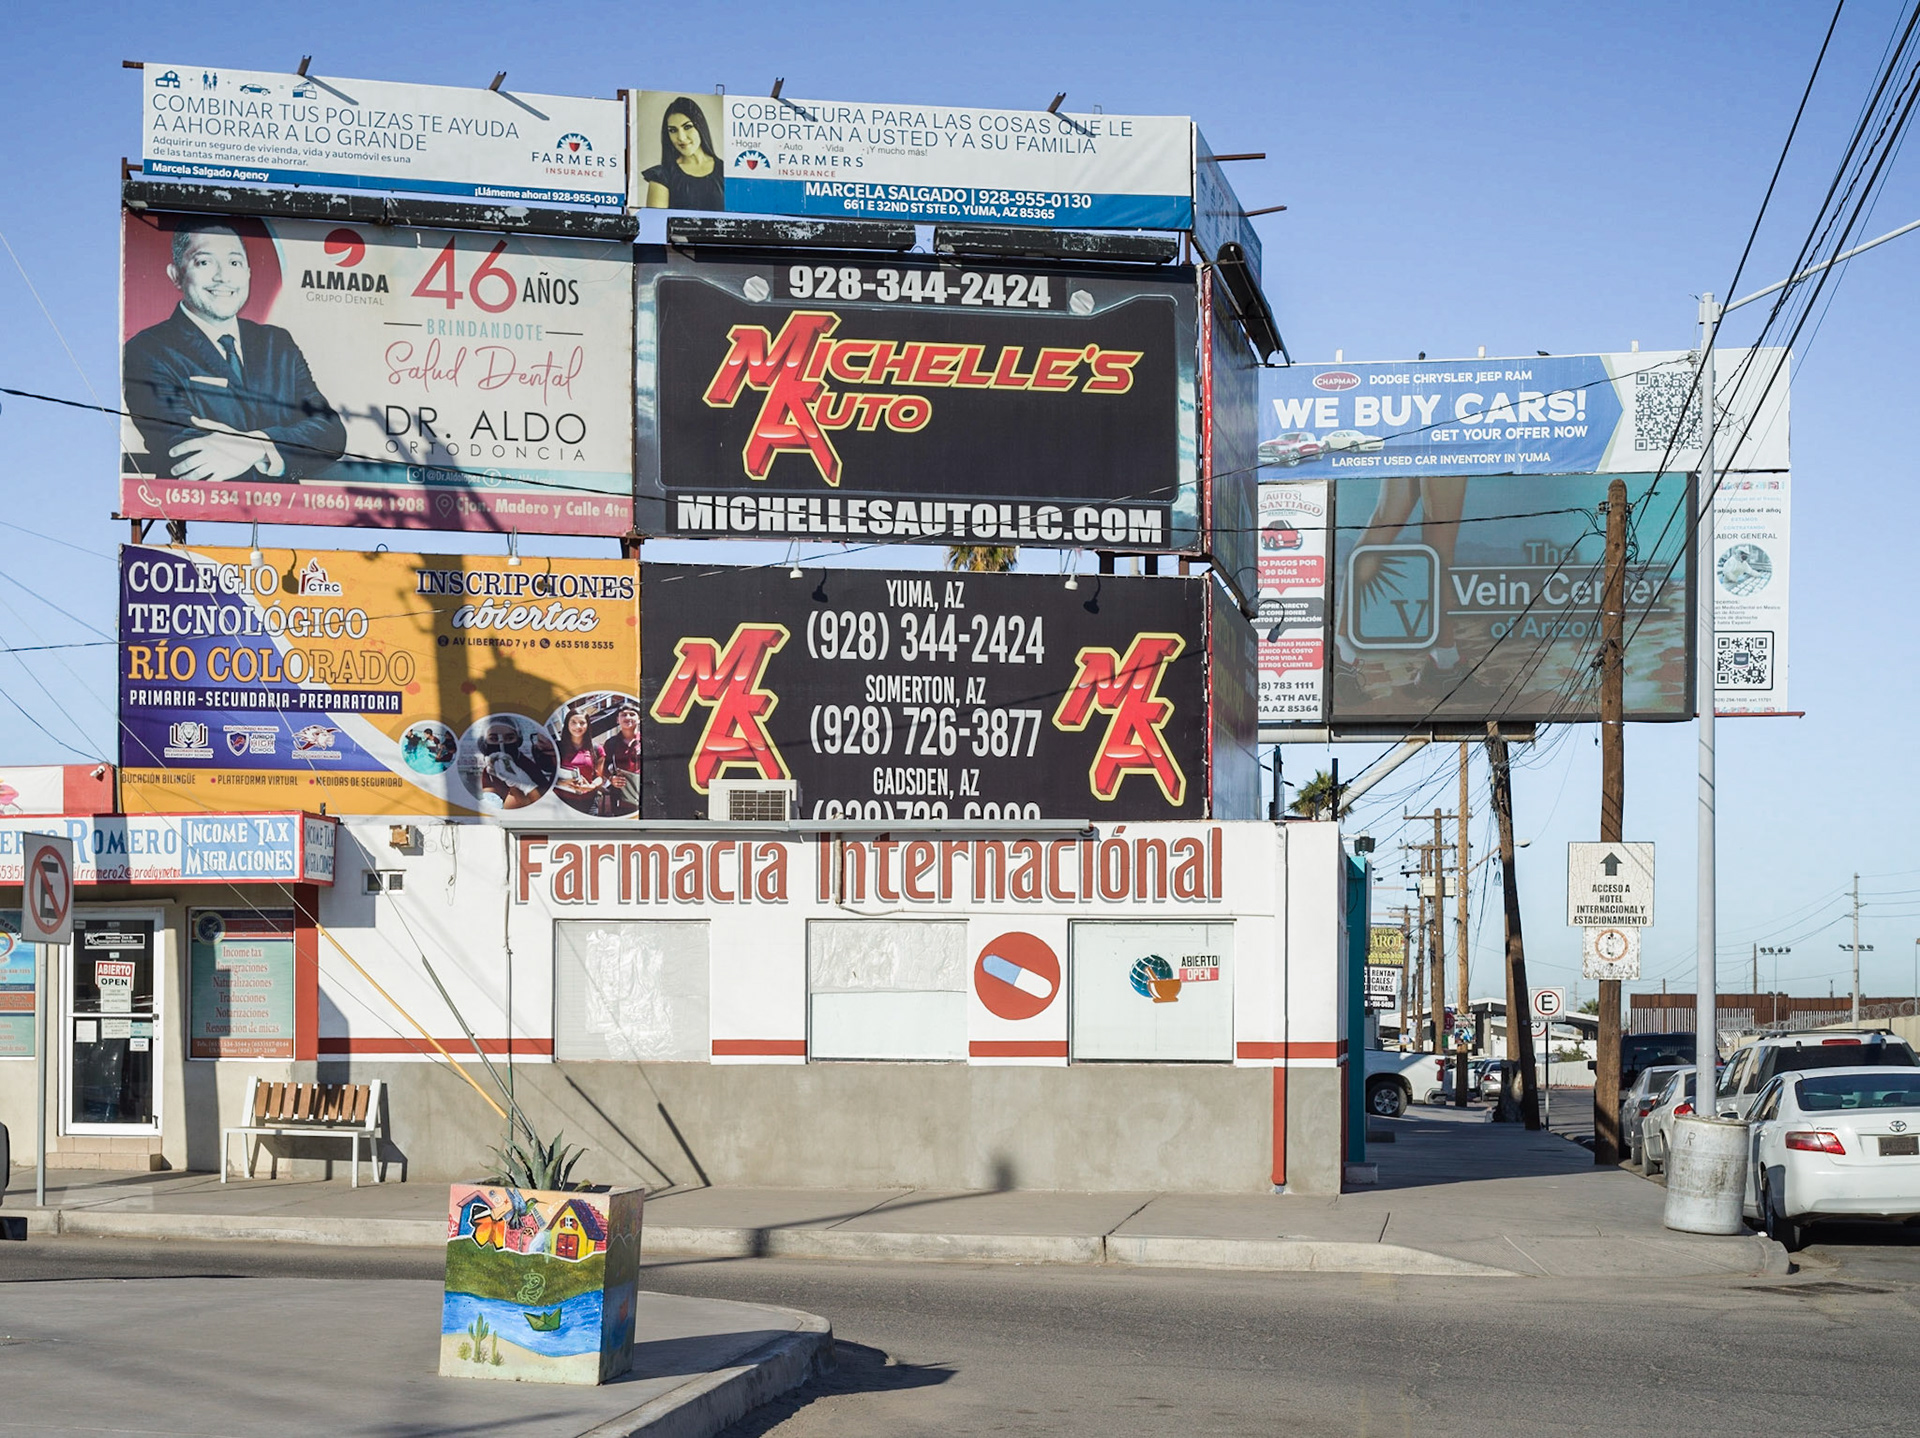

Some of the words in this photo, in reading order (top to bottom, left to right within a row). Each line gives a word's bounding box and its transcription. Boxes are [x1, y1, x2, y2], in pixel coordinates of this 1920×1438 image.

[152, 93, 272, 120] COMBINAR
[279, 103, 319, 123] TUS
[326, 107, 413, 130] POLIZAS
[418, 114, 442, 133] TE
[447, 116, 519, 139] AYUDA
[732, 102, 866, 124] COBERTURA
[872, 110, 927, 128] PARA
[934, 112, 972, 130] LAS
[978, 116, 1050, 135] COSAS
[1058, 119, 1102, 137] QUE
[1110, 121, 1133, 137] LE
[153, 114, 167, 131] A
[172, 115, 279, 140] AHORRAR
[285, 124, 299, 142] A
[305, 126, 330, 144] LO
[337, 128, 427, 151] GRANDE
[732, 122, 842, 142] IMPORTAN
[868, 128, 938, 148] USTED
[981, 134, 1008, 151] SU
[1016, 136, 1096, 154] FAMILIA
[152, 136, 193, 149] Adquirir
[208, 142, 242, 154] seguro
[182, 148, 213, 160] tantas
[214, 152, 256, 163] maneras
[532, 152, 617, 168] FARMERS
[778, 154, 864, 168] FARMERS
[152, 162, 191, 175] Marcela
[192, 166, 232, 180] Salgado
[233, 168, 269, 182] Agency
[546, 168, 604, 178] INSURANCE
[778, 170, 836, 178] INSURANCE
[474, 187, 520, 200] ¡Llámeme
[521, 190, 551, 201] ahora!
[552, 192, 618, 205] 928-955-0130
[806, 182, 886, 200] MARCELA
[888, 186, 967, 203] SALGADO
[978, 190, 1092, 209] 928-955-0130
[844, 200, 865, 210] 661
[876, 201, 908, 213] 32ND
[926, 204, 948, 215] STE
[962, 205, 1000, 218] YUMA,
[1002, 207, 1018, 218] AZ
[1020, 208, 1056, 220] 85365
[301, 270, 390, 294] ALMADA
[411, 235, 518, 314] 46
[522, 272, 580, 306] AÑOS
[788, 265, 1052, 309] 928-344-2424
[427, 319, 543, 341] BRINDANDOTE
[385, 338, 467, 393] Salud
[475, 346, 584, 406] Dental
[1316, 377, 1358, 387] CHAPMAN
[1369, 374, 1410, 385] DODGE
[1414, 372, 1472, 384] CHRYSLER
[1476, 372, 1502, 383] JEEP
[1505, 370, 1532, 382] RAM
[1272, 397, 1339, 428] WE
[1354, 394, 1442, 427] BUY
[1455, 389, 1588, 425] CARS!
[386, 405, 451, 438] DR.
[470, 410, 586, 444] ALDO
[1431, 428, 1460, 442] GET
[1462, 428, 1502, 441] YOUR
[1504, 427, 1550, 440] OFFER
[1554, 426, 1588, 438] NOW
[386, 440, 585, 461] ORTODONCIA
[1332, 456, 1381, 467] LARGEST
[1384, 455, 1412, 466] USED
[1414, 454, 1437, 466] CAR
[1440, 453, 1502, 465] INVENTORY
[1518, 452, 1551, 463] YUMA
[166, 488, 206, 506] (653)
[210, 490, 239, 505] 534
[246, 492, 282, 508] 1049
[303, 494, 350, 511] 1(866)
[354, 496, 383, 511] 444
[390, 497, 425, 512] 1908
[1260, 500, 1320, 514] SANTIAGO
[1266, 492, 1298, 500] AUTOS
[496, 499, 548, 515] Madero
[566, 501, 600, 518] Calle
[604, 502, 628, 518] 4ta
[676, 495, 1163, 544] MICHELLESAUTOLLC.COM
[1740, 532, 1778, 540] GENERAL
[1526, 542, 1576, 564] The
[128, 561, 279, 596] COLEGIO
[309, 583, 340, 593] CTRC
[416, 570, 635, 600] INSCRIPCIONES
[1451, 574, 1530, 606] Vein
[1542, 572, 1665, 606] Cener
[886, 581, 940, 612] YUMA,
[944, 582, 965, 608] AZ
[128, 600, 370, 640] TECNOLÓGICO
[452, 598, 600, 632] abiertas
[1390, 600, 1428, 637] V
[806, 610, 890, 661] (928)
[900, 613, 1044, 665] 344-2424
[1491, 617, 1516, 638] of
[1522, 615, 1603, 638] Arizon
[468, 638, 513, 648] LIBERTAD
[127, 640, 197, 682] RÍO
[206, 646, 416, 686] COLORADO
[865, 674, 960, 708] SOMERTON,
[964, 676, 986, 706] AZ
[1274, 682, 1292, 690] 783
[1052, 632, 1187, 806] MA
[810, 704, 893, 754] (928)
[903, 706, 1042, 758] 726-3877
[218, 775, 266, 786] PLATAFORMA
[268, 776, 298, 786] VIRTUAL
[361, 777, 403, 788] SEGURIDAD
[873, 767, 954, 800] GADSDEN,
[960, 768, 980, 796] AZ
[64, 820, 177, 863] ROMERO
[186, 820, 248, 847] INCOME
[254, 819, 290, 846] TAX
[185, 848, 292, 876] MIGRACIONES
[515, 832, 789, 904] Farmacia
[1592, 884, 1623, 893] ACCESO
[1600, 894, 1623, 903] HOTEL
[1574, 916, 1648, 925] ESTACIONAMIENTO
[1576, 905, 1638, 914] INTERNACIONAL
[223, 946, 250, 957] Income
[251, 948, 262, 957] tax
[1182, 956, 1218, 967] ABIERTO
[98, 964, 131, 976] ABIERTO
[1187, 968, 1210, 980] OPEN
[100, 978, 128, 986] OPEN
[1542, 994, 1553, 1011] E
